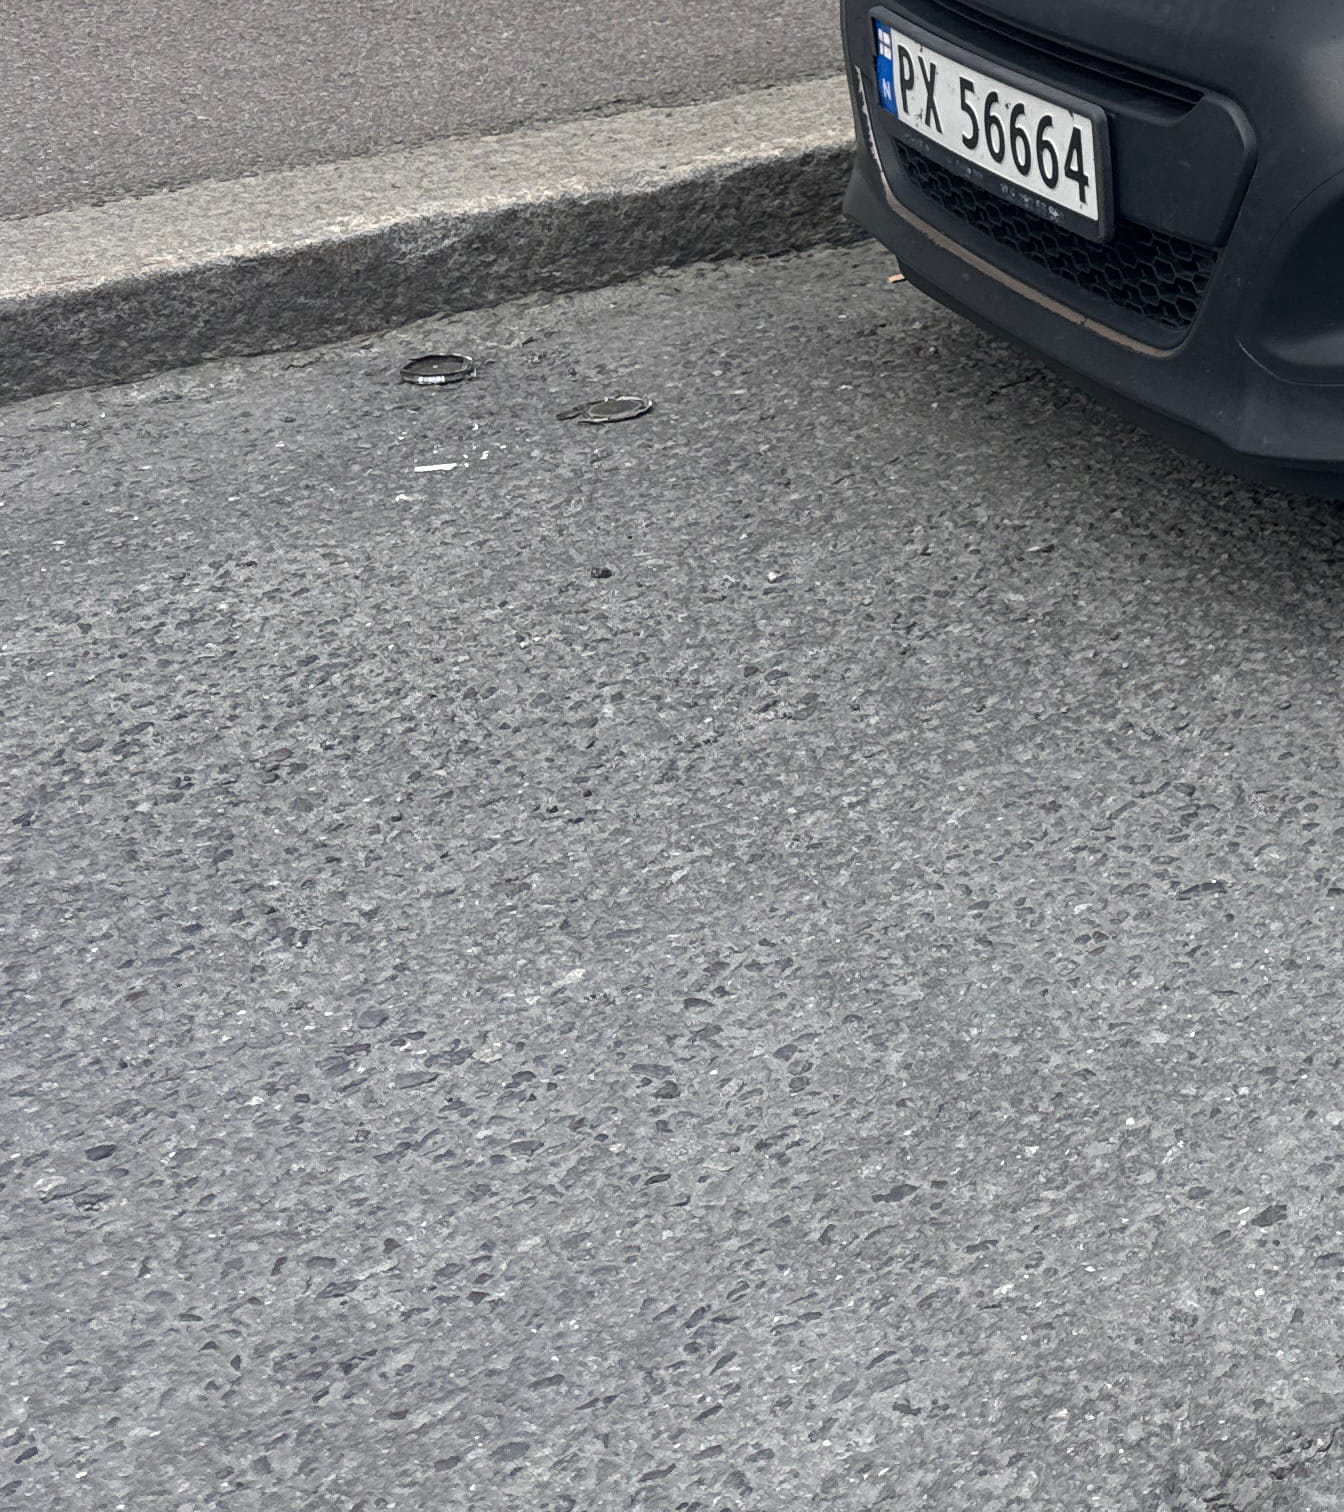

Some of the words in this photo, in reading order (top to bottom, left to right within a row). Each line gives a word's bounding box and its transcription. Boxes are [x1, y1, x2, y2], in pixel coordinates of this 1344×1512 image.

[881, 78, 892, 101] N
[897, 44, 943, 134] PX
[958, 76, 1089, 204] 56664
